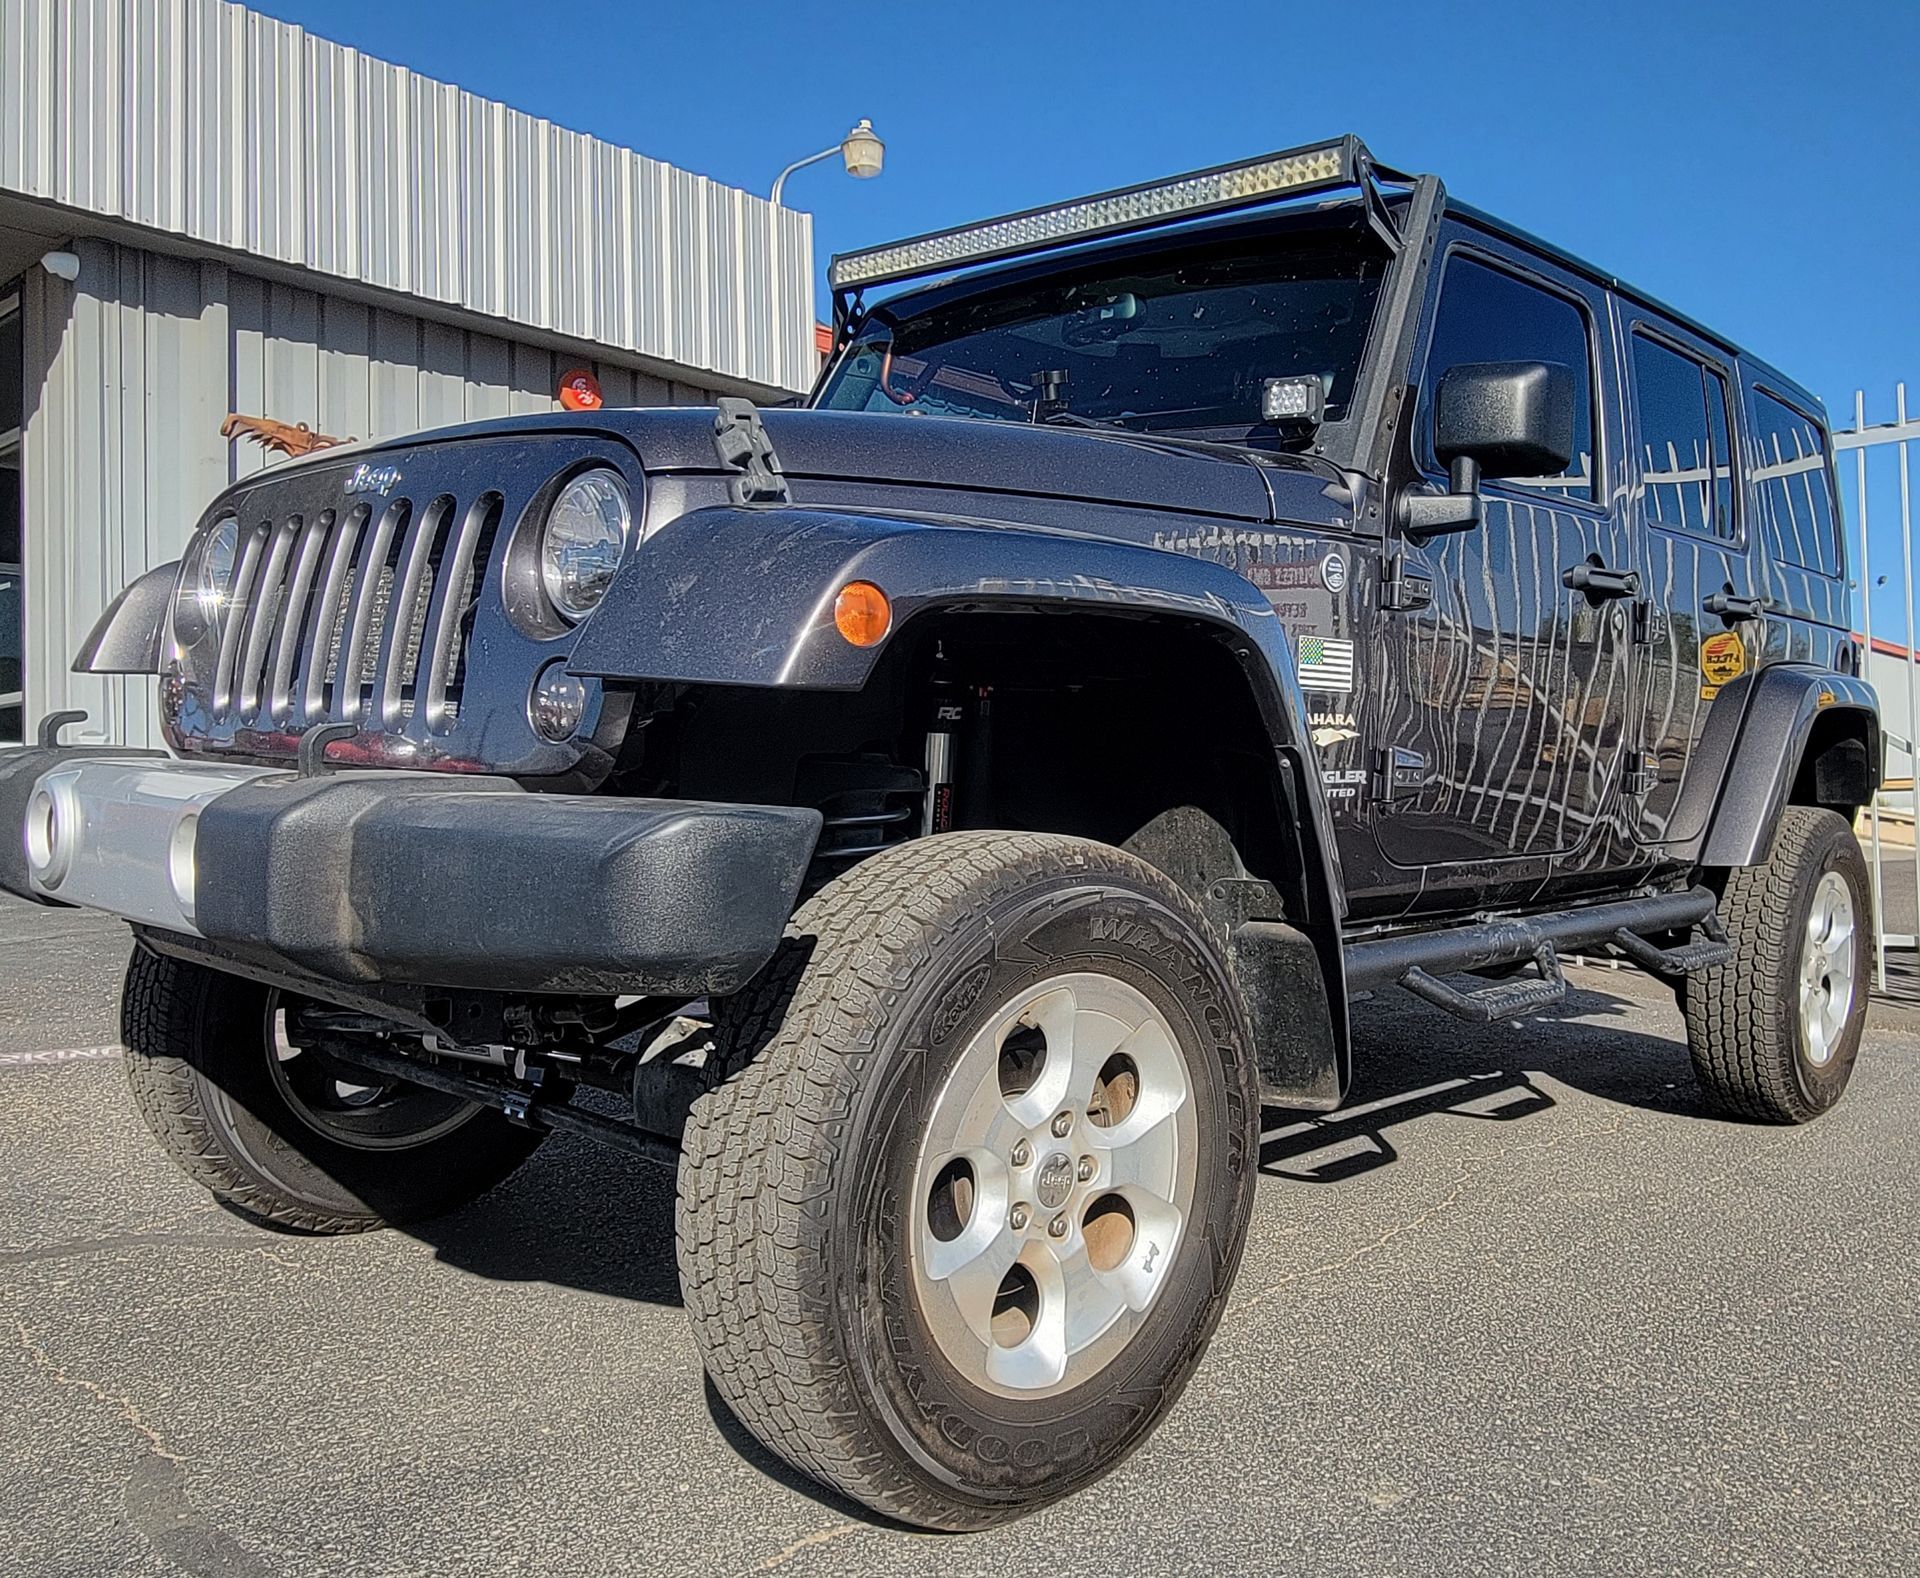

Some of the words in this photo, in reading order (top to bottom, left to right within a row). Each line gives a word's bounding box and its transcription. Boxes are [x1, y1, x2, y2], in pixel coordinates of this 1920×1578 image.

[344, 464, 402, 497] Jeep
[1322, 770, 1368, 785] GLER
[1089, 916, 1244, 1177] WRANGLER
[1042, 1171, 1071, 1191] Jeep
[879, 1187, 1090, 1468] GOODYEAR
